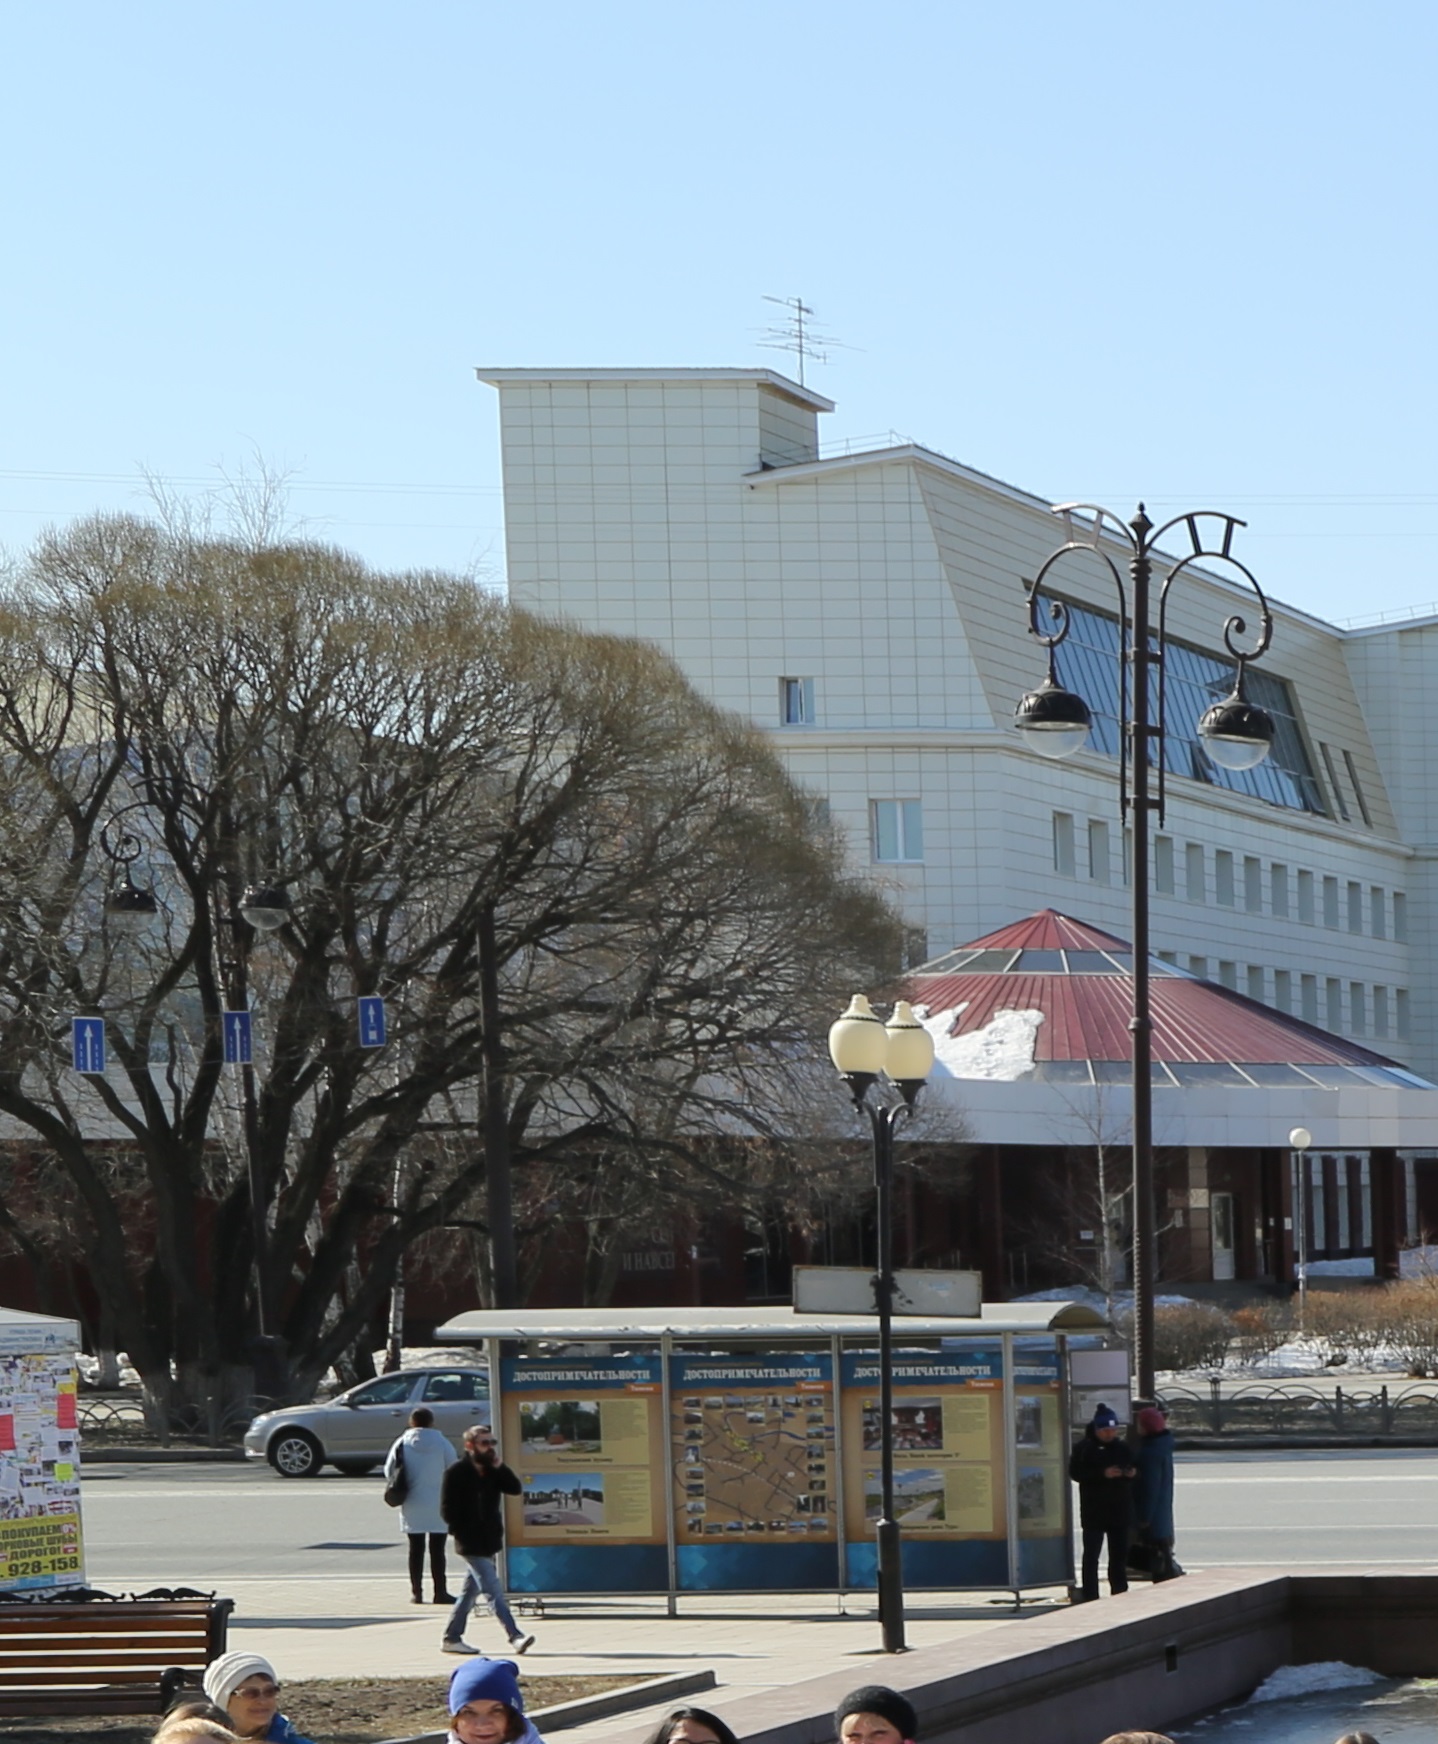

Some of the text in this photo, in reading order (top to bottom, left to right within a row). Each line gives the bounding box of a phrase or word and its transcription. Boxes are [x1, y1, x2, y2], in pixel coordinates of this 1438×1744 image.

[513, 1369, 651, 1383] ДОСТОПРИМЕЧАТЕЛЬНОСТИ
[683, 1367, 822, 1381] ДОСТОПРИМЕЧАТЕЛЬНОСТИ
[0, 1537, 44, 1552] ОРКОВЫЕ
[9, 1546, 61, 1562] ДОРОГО!
[8, 1556, 79, 1577] 928-158
